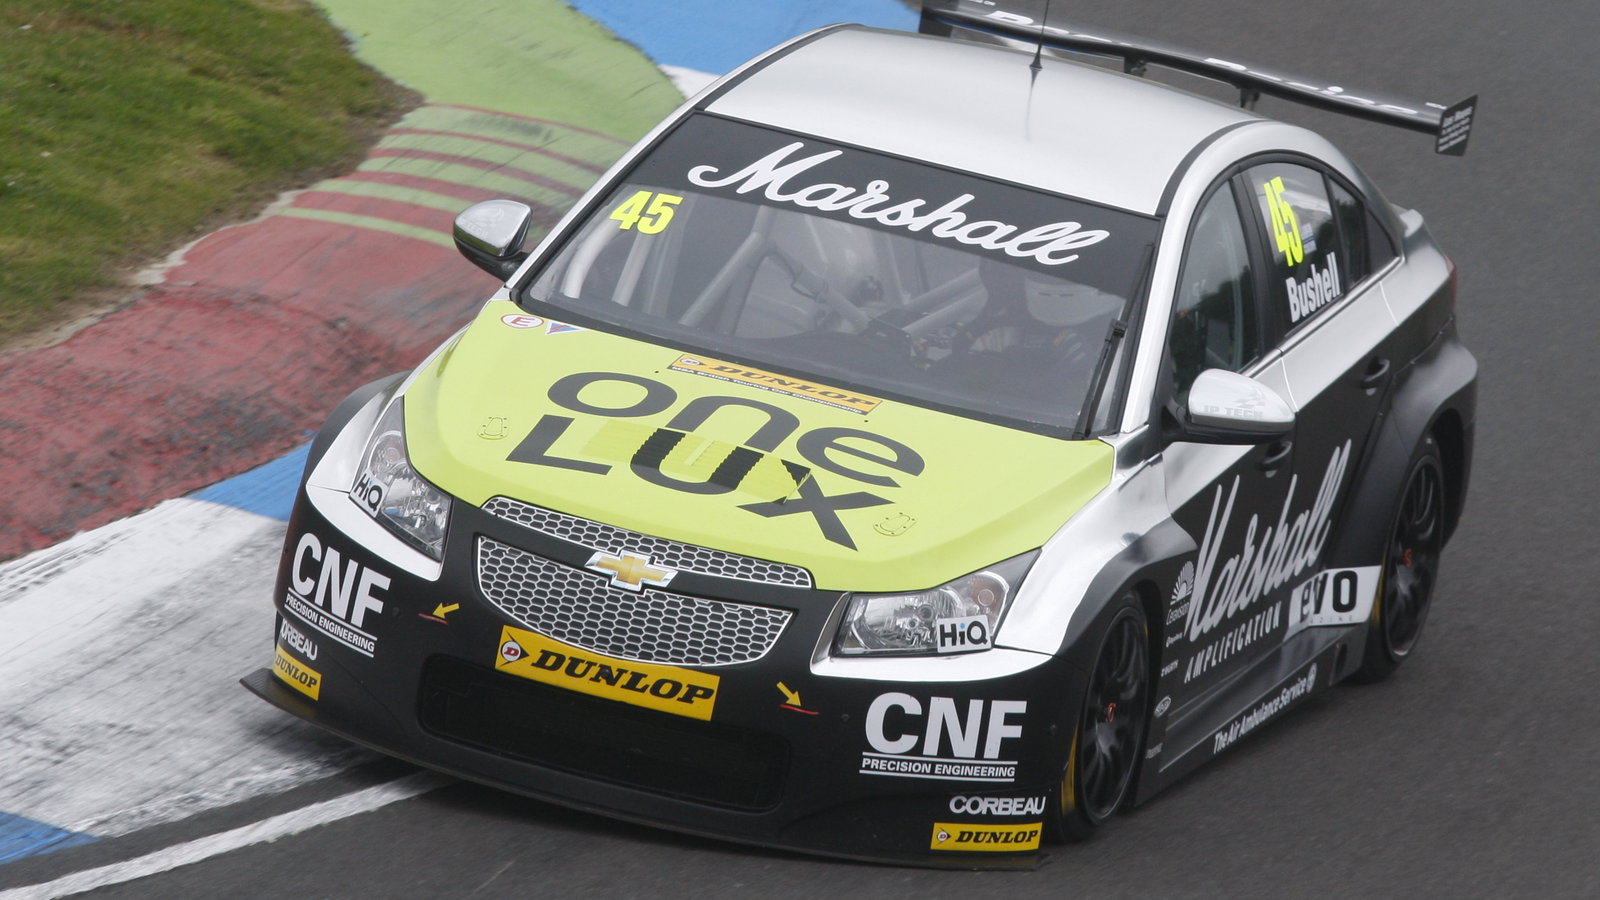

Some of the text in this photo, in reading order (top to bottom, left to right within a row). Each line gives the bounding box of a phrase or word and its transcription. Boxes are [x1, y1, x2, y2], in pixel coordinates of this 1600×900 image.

[609, 190, 683, 236] 45
[687, 141, 1110, 266] Marshall
[1264, 176, 1304, 267] 45
[1285, 252, 1341, 322] Bushell
[708, 365, 876, 406] DUNLOP
[547, 372, 925, 488] one
[354, 475, 383, 511] HiQ
[505, 414, 895, 551] LUX
[1184, 438, 1352, 642] Marshall
[292, 532, 391, 628] CNF
[280, 617, 318, 661] ORBEAU
[285, 592, 376, 653] PRECISION ENGINEERING
[939, 620, 988, 647] HiQ
[1184, 601, 1282, 684] AMPLIFICATION
[276, 653, 318, 688] DUNLOP
[531, 649, 715, 704] DUNLOP
[865, 692, 1027, 759] CNF
[1213, 730, 1228, 755] The
[1227, 720, 1241, 747] Air
[1279, 677, 1307, 709] Service
[862, 757, 1016, 777] PRECISION ENGINEERING
[950, 795, 1046, 815] CORBEAU
[955, 829, 1039, 844] DUNLOP
